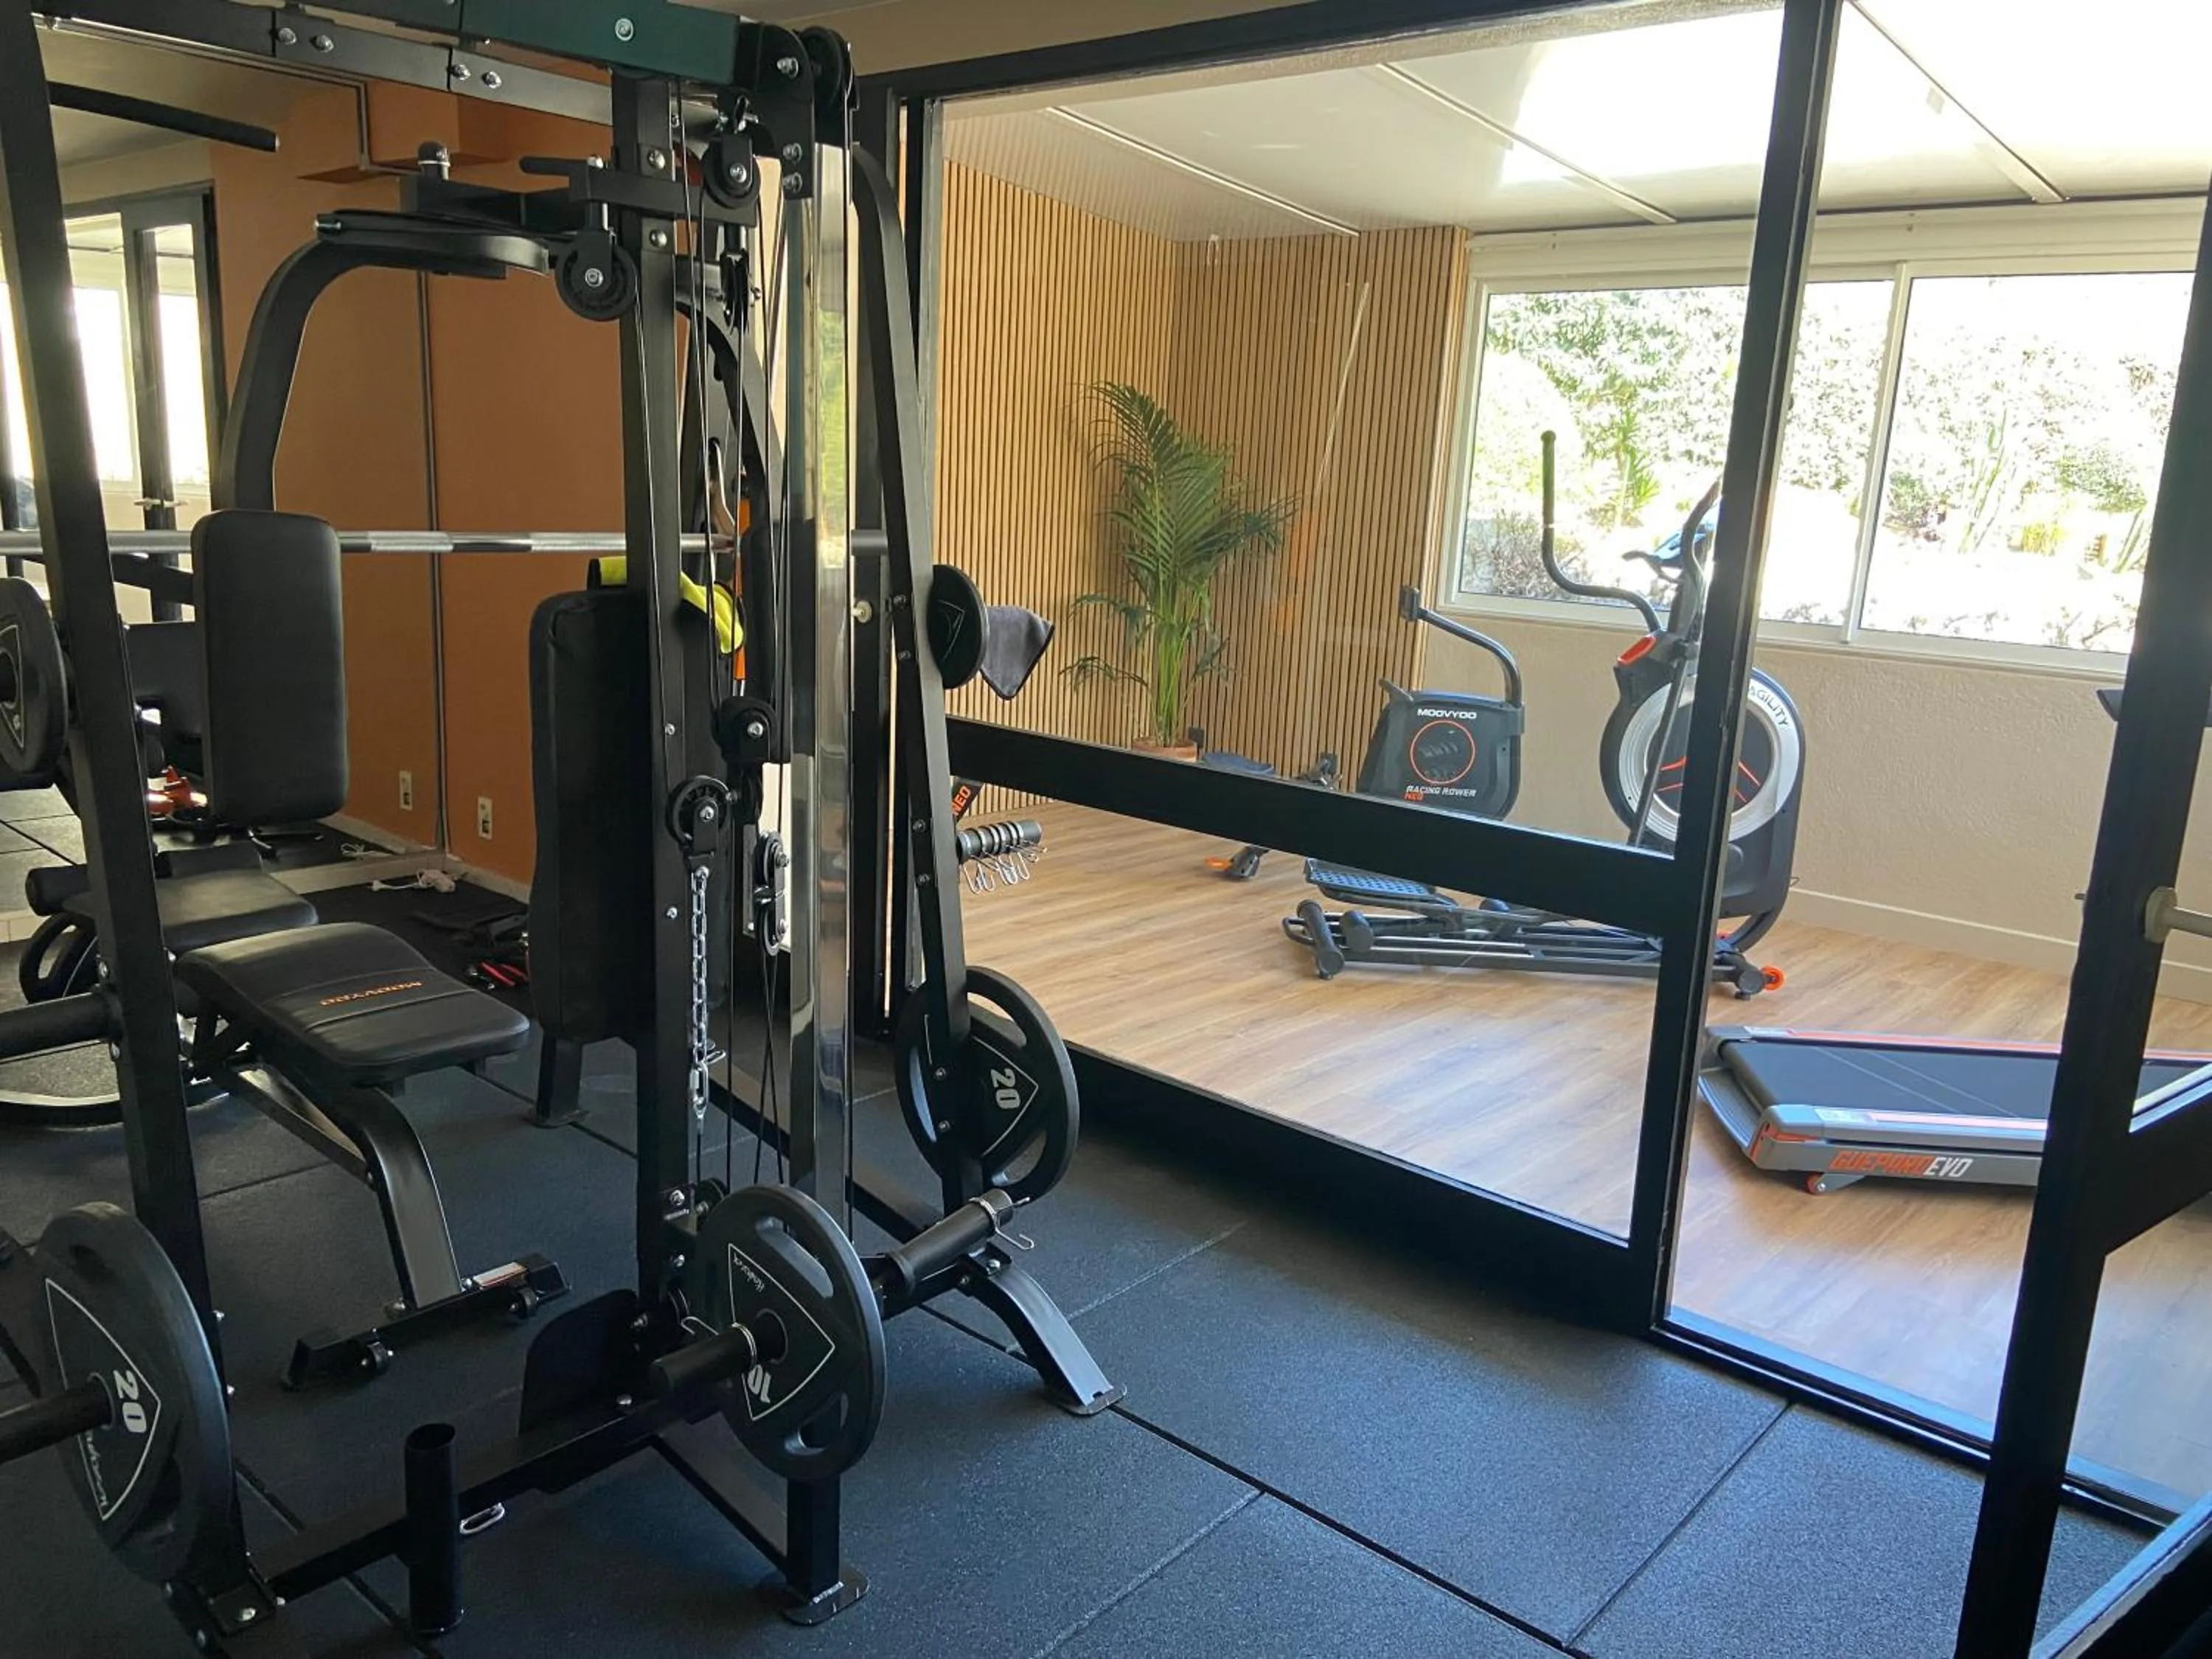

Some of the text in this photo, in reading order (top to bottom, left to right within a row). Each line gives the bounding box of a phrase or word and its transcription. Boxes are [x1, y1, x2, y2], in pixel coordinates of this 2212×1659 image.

[1417, 709, 1477, 720] MOOVYOO
[1406, 785, 1477, 797] RACING ROWER
[990, 1068, 1021, 1110] 20
[112, 1369, 147, 1433] 20
[747, 1364, 772, 1403] 10
